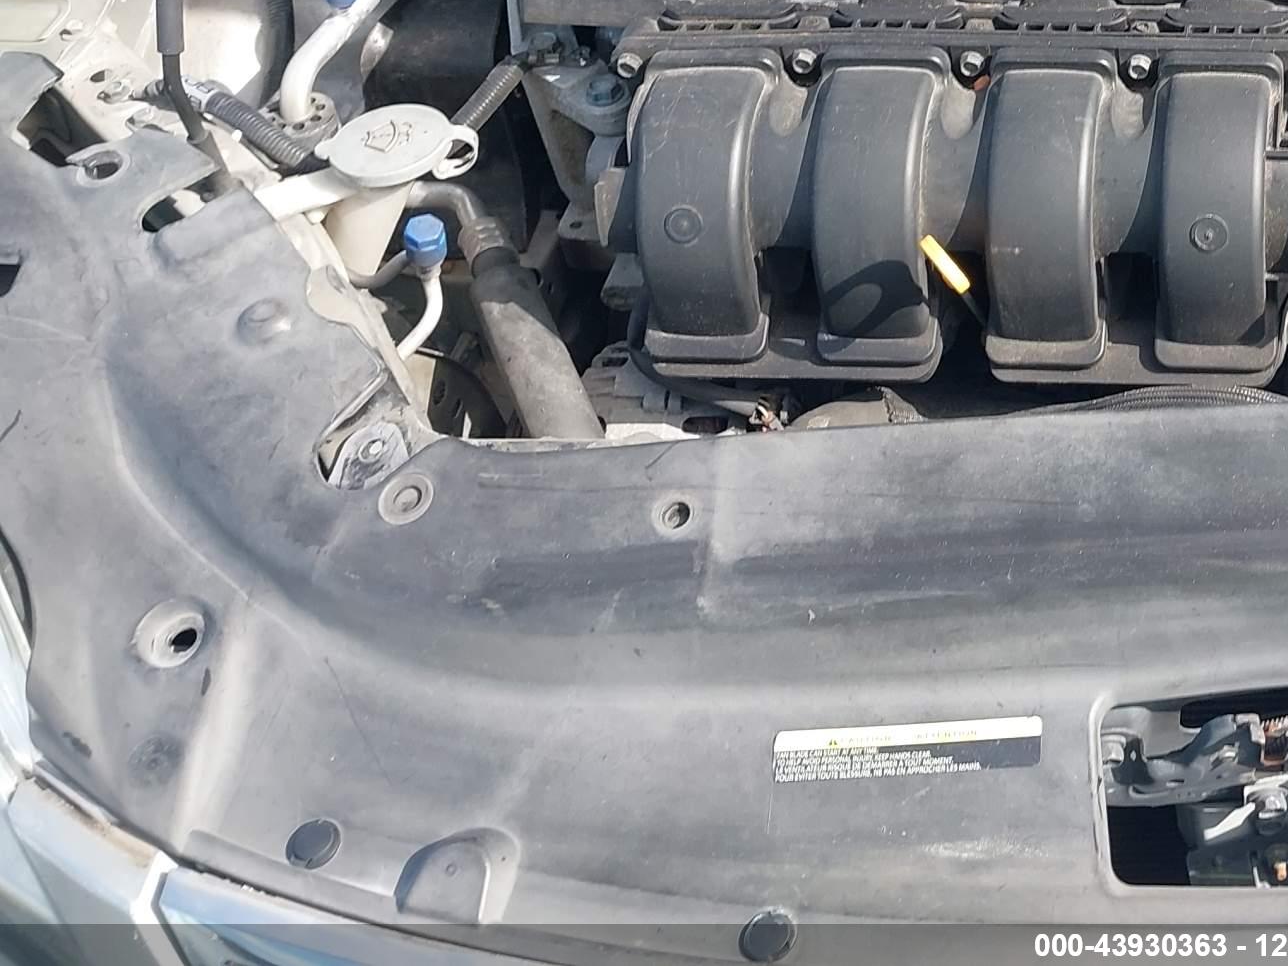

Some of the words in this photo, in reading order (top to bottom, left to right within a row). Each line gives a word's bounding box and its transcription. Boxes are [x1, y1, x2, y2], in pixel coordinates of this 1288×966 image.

[809, 749, 823, 757] CAN
[874, 752, 889, 761] KEEP
[889, 751, 911, 760] HANDS
[775, 772, 795, 782] POUR
[817, 770, 839, 781] TOUTE
[883, 768, 896, 778] PAS
[946, 763, 958, 773] LES
